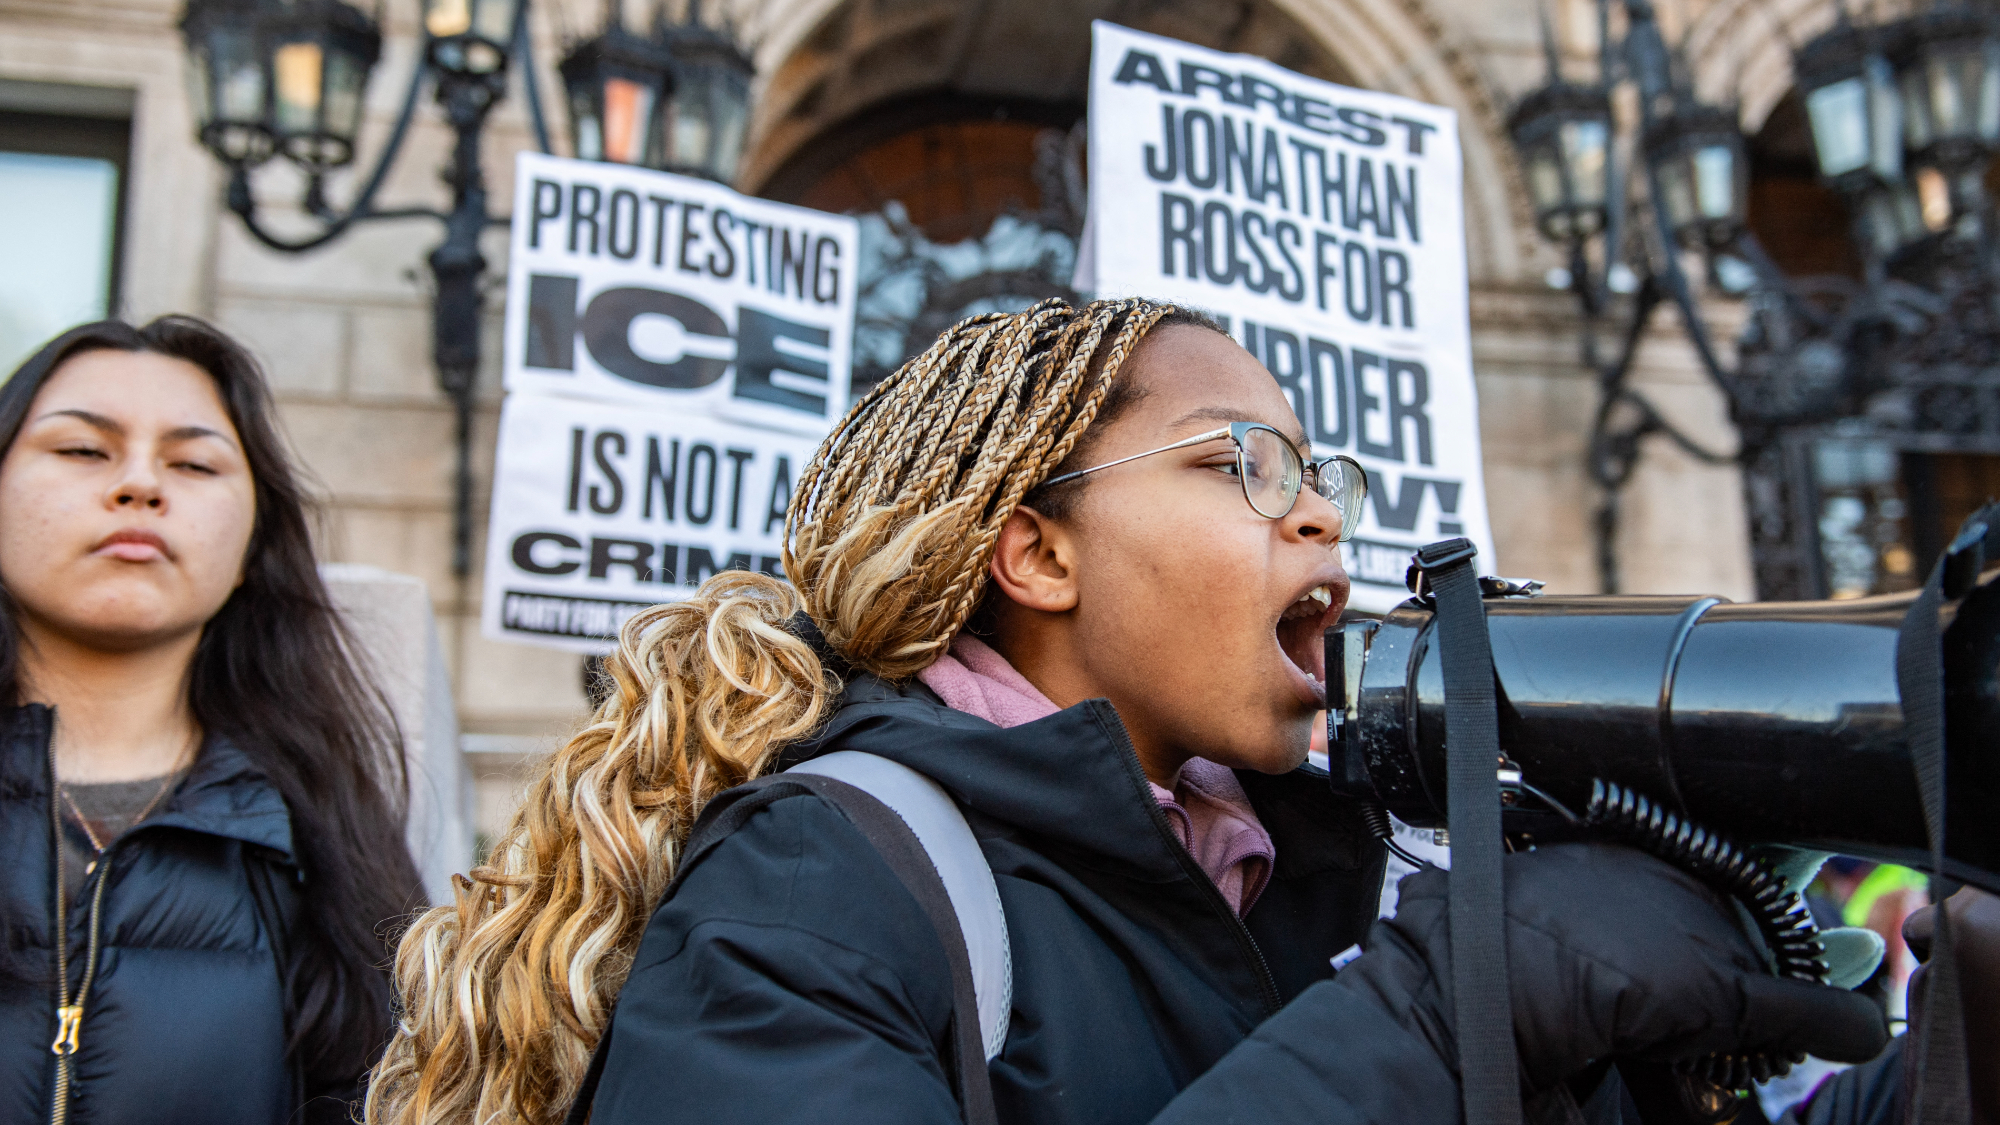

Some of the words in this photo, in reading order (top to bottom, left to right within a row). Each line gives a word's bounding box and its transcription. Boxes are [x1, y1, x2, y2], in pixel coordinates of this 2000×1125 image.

[1113, 48, 1437, 155] ARREST
[1143, 103, 1421, 243] JONATHAN
[530, 178, 842, 306] PROTESTING
[1160, 192, 1306, 303] ROSS
[1315, 231, 1418, 329] FOR
[524, 274, 831, 417] ICE
[567, 427, 628, 515] IS
[643, 434, 755, 531] NOT
